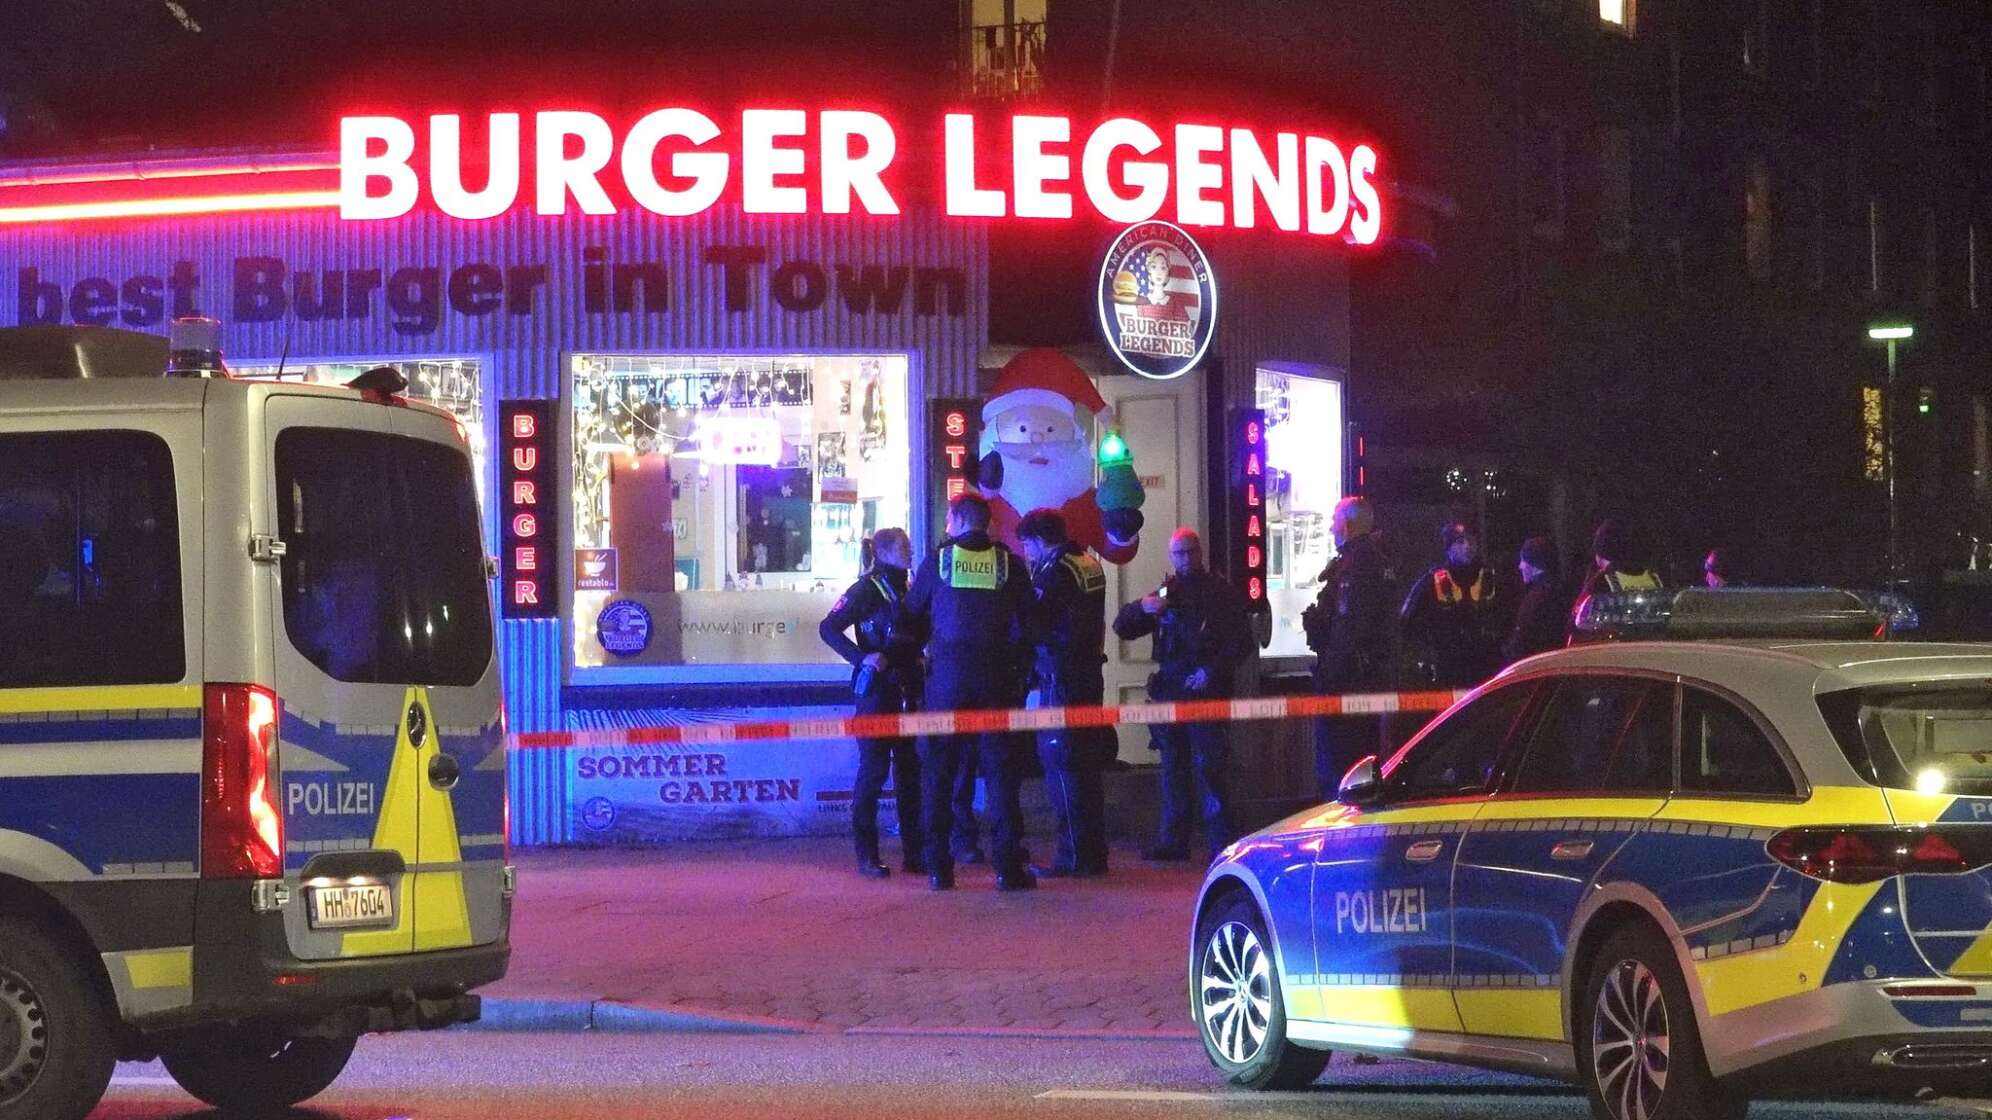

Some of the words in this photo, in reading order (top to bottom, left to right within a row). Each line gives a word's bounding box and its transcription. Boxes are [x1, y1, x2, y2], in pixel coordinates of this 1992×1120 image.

[339, 107, 901, 220] BURGER
[944, 112, 1382, 245] LEGENDS
[1105, 226, 1168, 279] AMERICAN
[1174, 231, 1208, 283] DINER
[18, 260, 201, 327] best
[234, 255, 546, 337] Burger
[583, 246, 669, 314] in
[704, 245, 966, 316] Town
[1121, 334, 1195, 356] LEGENDS
[1126, 318, 1192, 338] BURGER
[946, 412, 966, 501] STE
[513, 415, 538, 604] BURGER
[1247, 422, 1262, 600] SALADS
[955, 560, 994, 574] POLIZEI
[577, 753, 728, 779] SOMMER
[288, 782, 374, 815] POLIZEI
[659, 778, 801, 804] GARTEN
[324, 890, 344, 918] HH
[1336, 887, 1426, 934] POLIZEI
